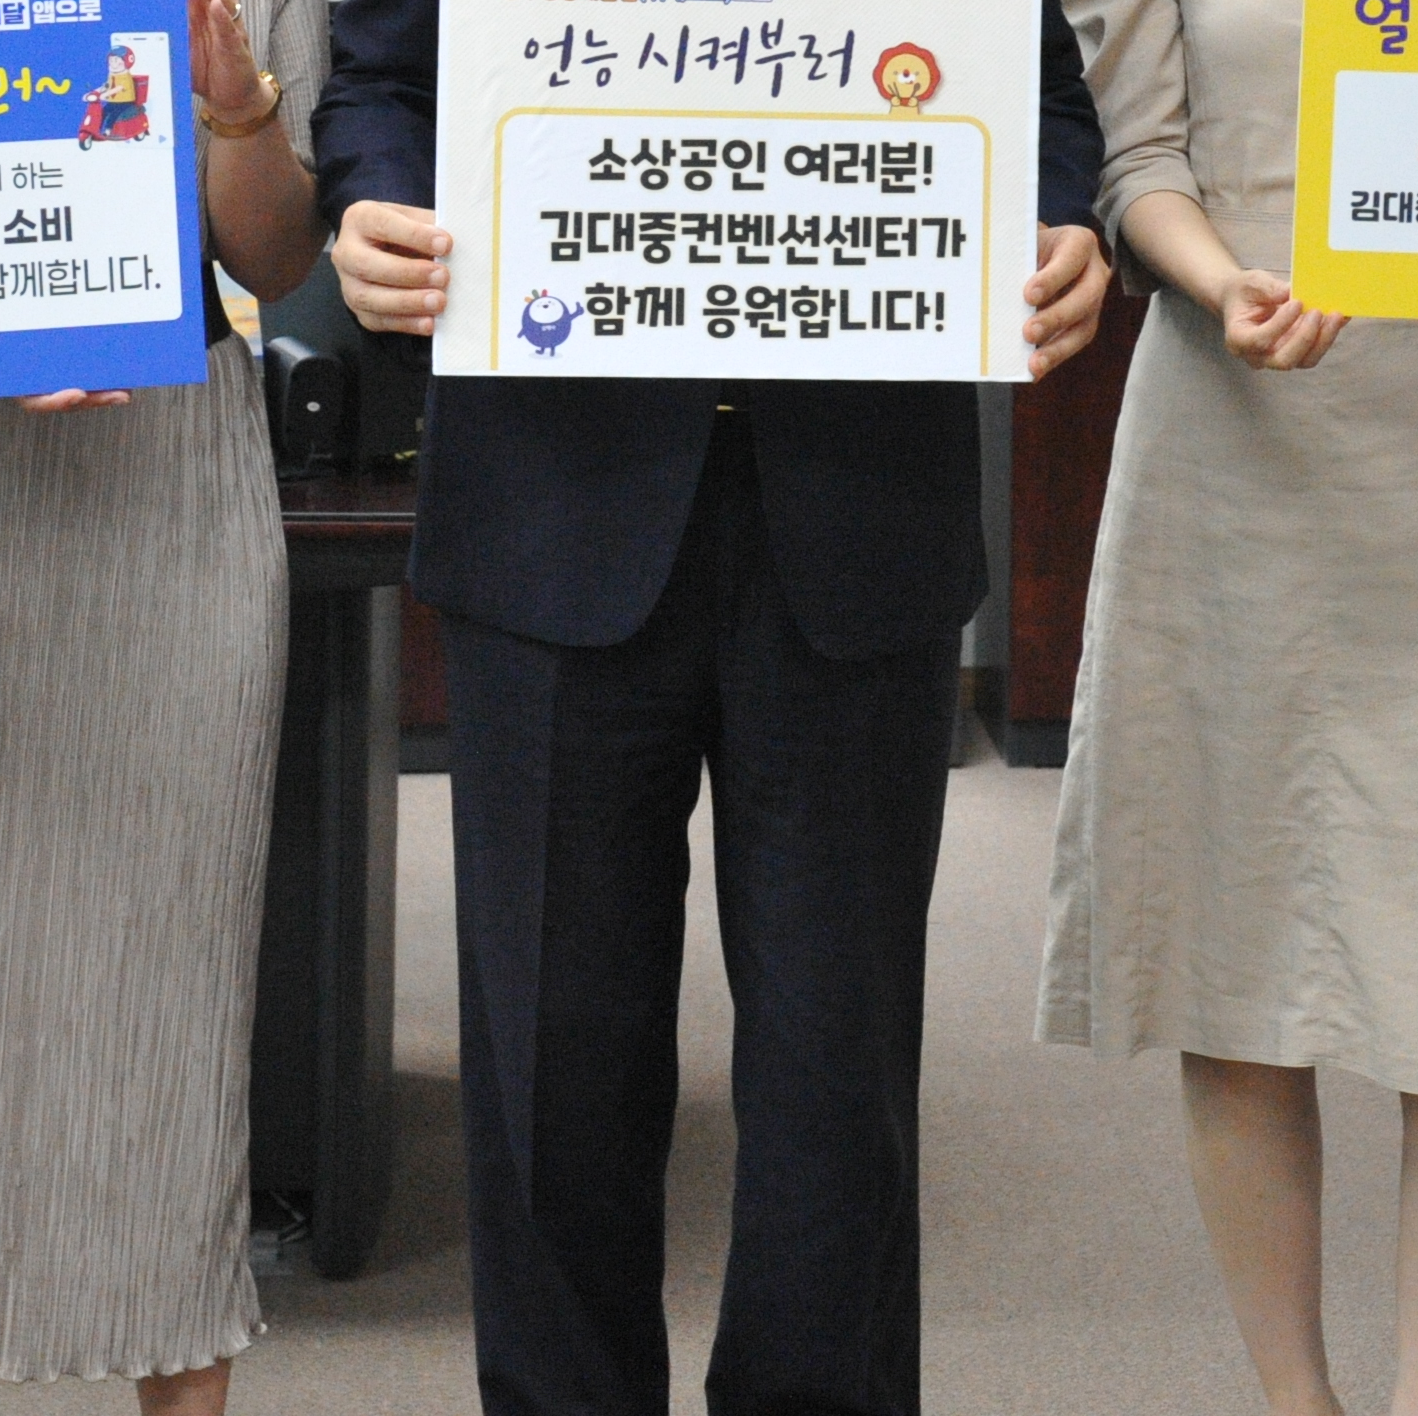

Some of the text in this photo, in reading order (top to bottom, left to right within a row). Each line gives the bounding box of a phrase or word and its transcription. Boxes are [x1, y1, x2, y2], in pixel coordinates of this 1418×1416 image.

[525, 18, 855, 98] 언능 시켜부러
[12, 163, 63, 190] 하는
[588, 138, 933, 193] 소상공인 여러분!
[4, 207, 73, 244] 소비
[540, 210, 965, 265] 김대중컨벤션센터가
[585, 283, 945, 339] 함께 응원합니다!
